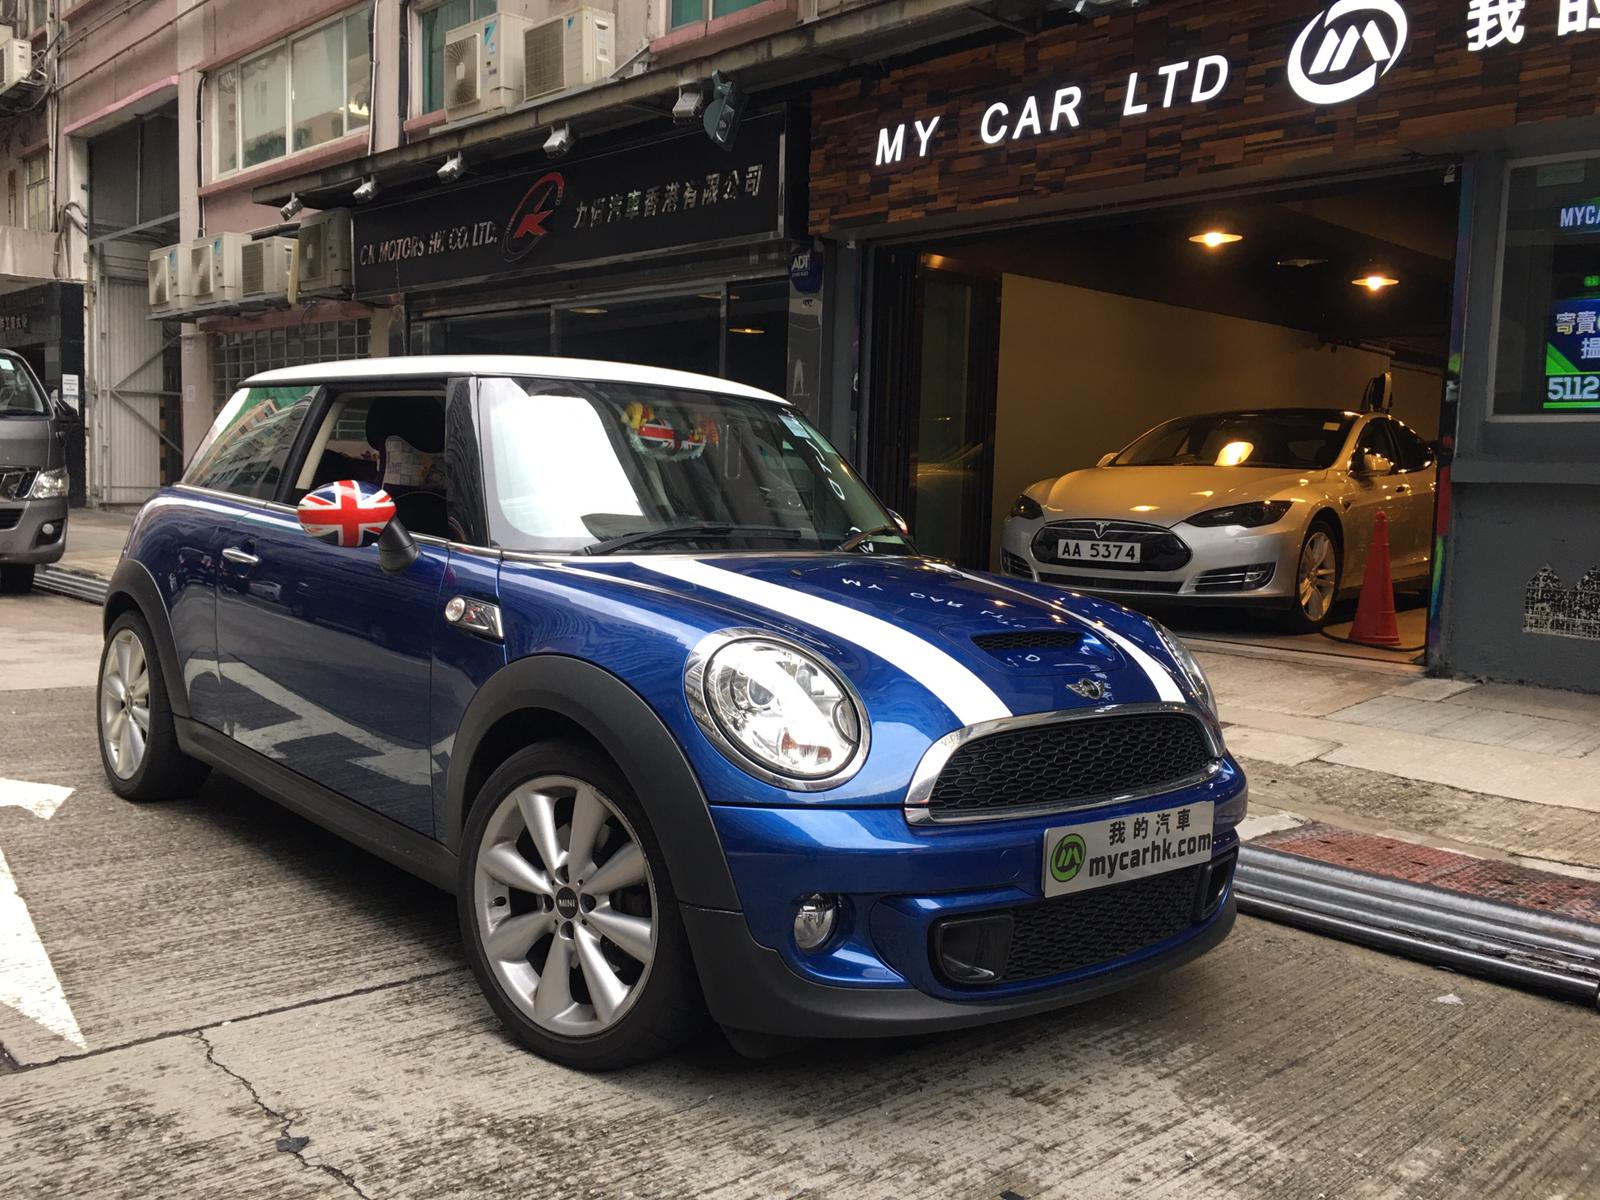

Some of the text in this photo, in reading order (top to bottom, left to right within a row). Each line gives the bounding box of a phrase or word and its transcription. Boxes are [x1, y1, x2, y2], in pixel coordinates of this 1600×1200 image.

[875, 55, 1229, 166] MY CAR LTD
[379, 236, 425, 262] MOTORS
[472, 220, 498, 247] LTD.
[791, 254, 810, 271] ADT
[1062, 541, 1135, 560] AA 5374
[1109, 809, 1191, 846] 我的汽車
[1089, 833, 1211, 879] mycarhk.com
